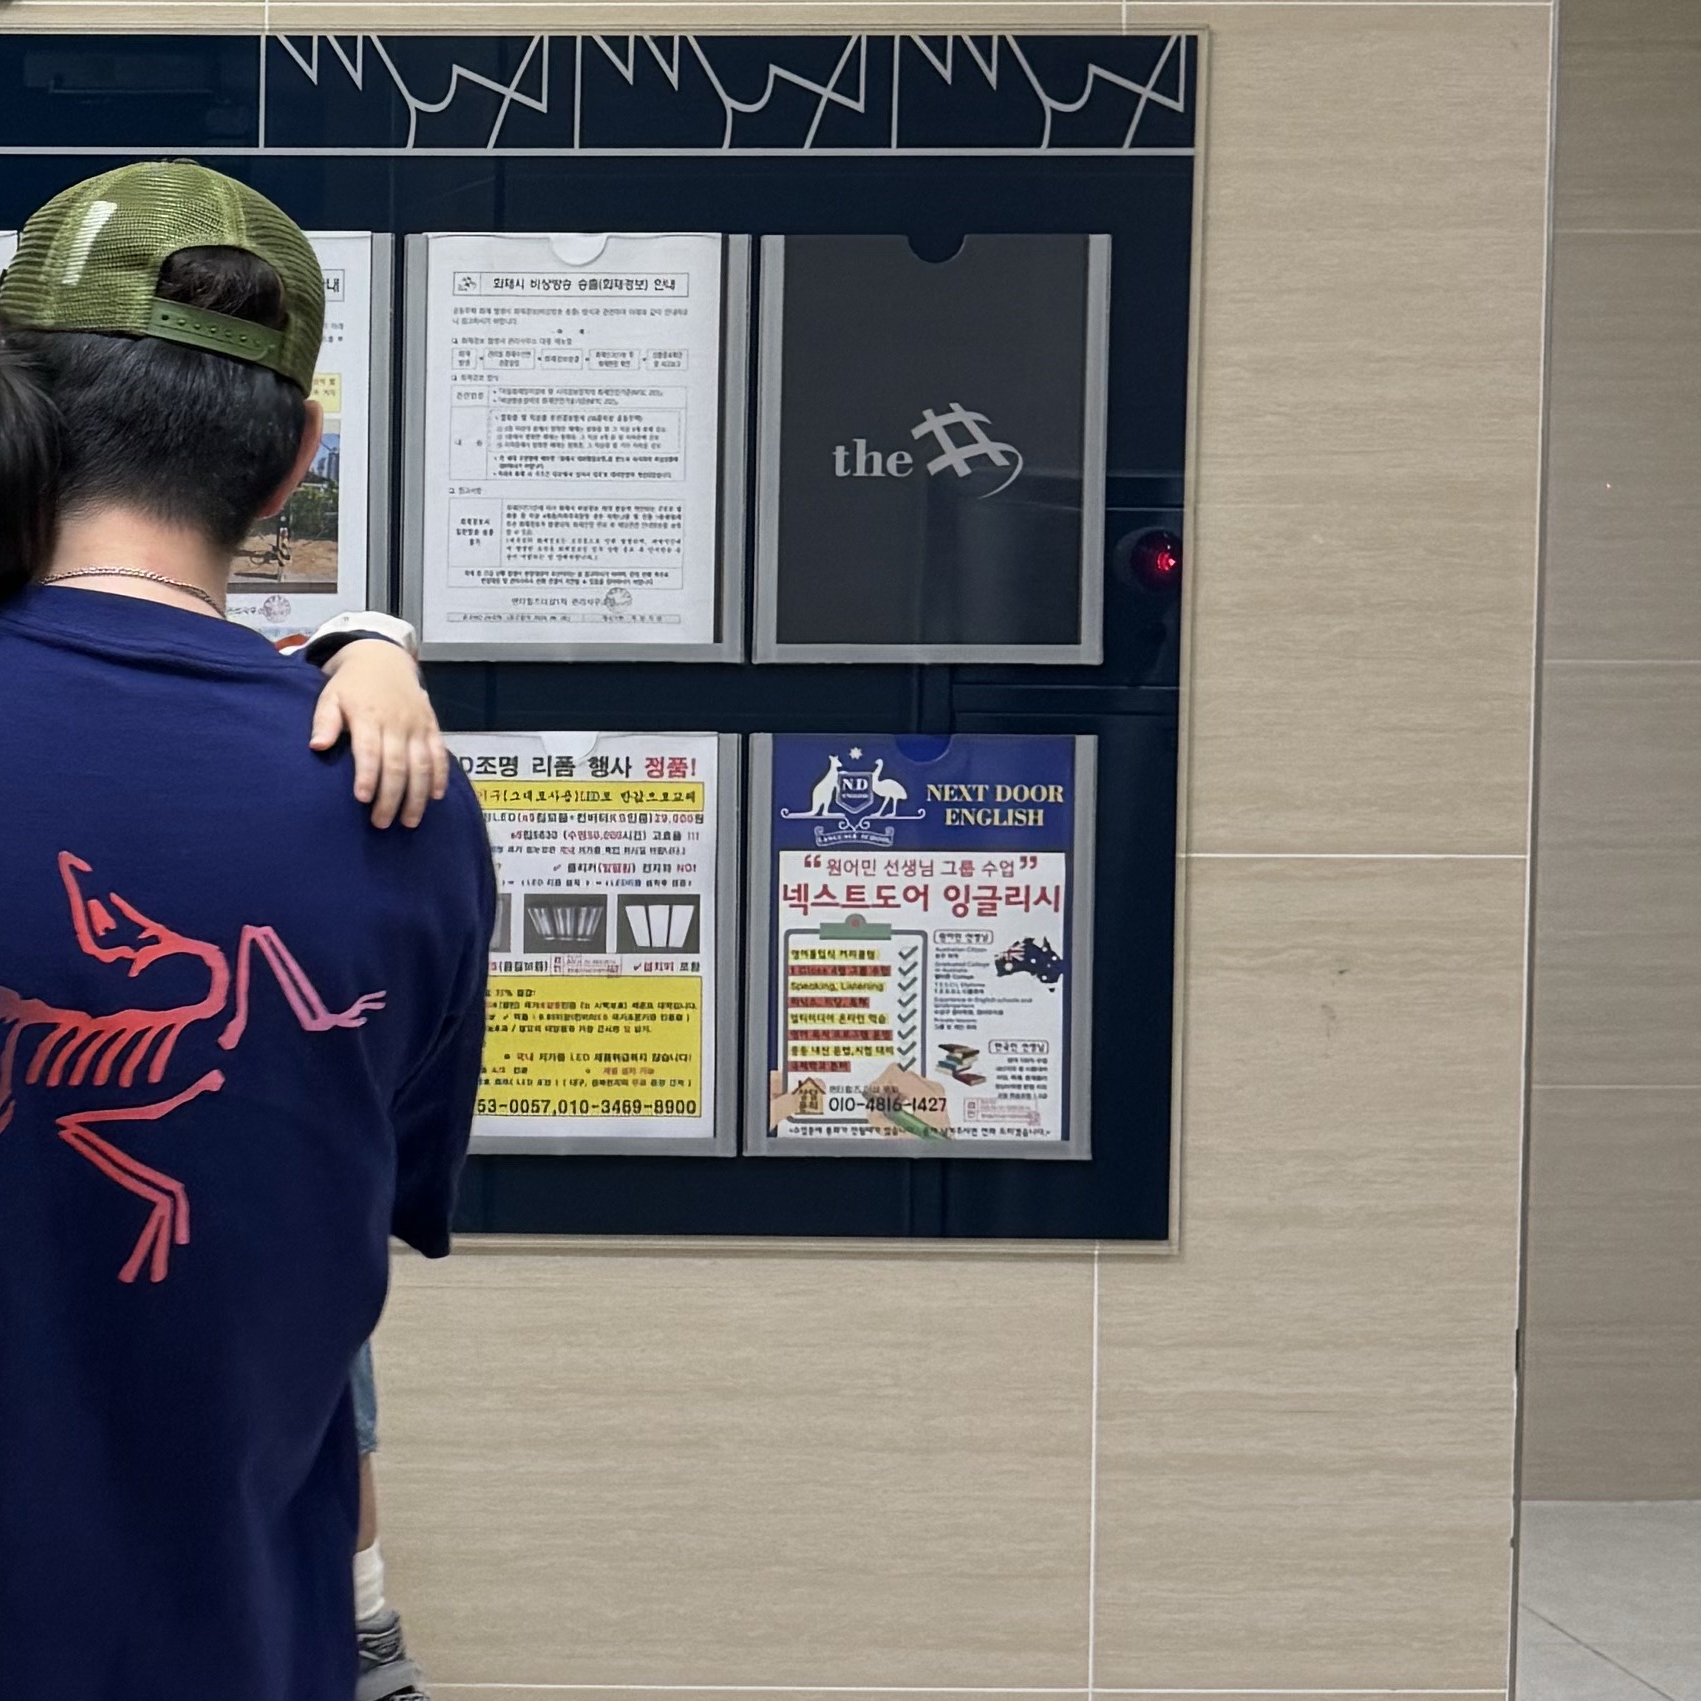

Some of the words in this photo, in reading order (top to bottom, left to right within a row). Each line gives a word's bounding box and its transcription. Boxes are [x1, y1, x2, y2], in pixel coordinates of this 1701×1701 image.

[654, 278, 676, 291] 안내
[832, 438, 914, 478] the
[532, 755, 576, 778] 리폼
[588, 755, 632, 778] 행사
[644, 756, 697, 779] 정품!
[926, 784, 989, 802] NEXT
[995, 785, 1065, 803] DOOR
[945, 808, 1045, 827] ENGLISH
[884, 859, 935, 877] 선생님
[940, 859, 976, 877] 그룹
[783, 884, 930, 917] 넥스트도어
[943, 884, 1061, 919] 잉글리시
[828, 1097, 948, 1113] 010-4816-1427
